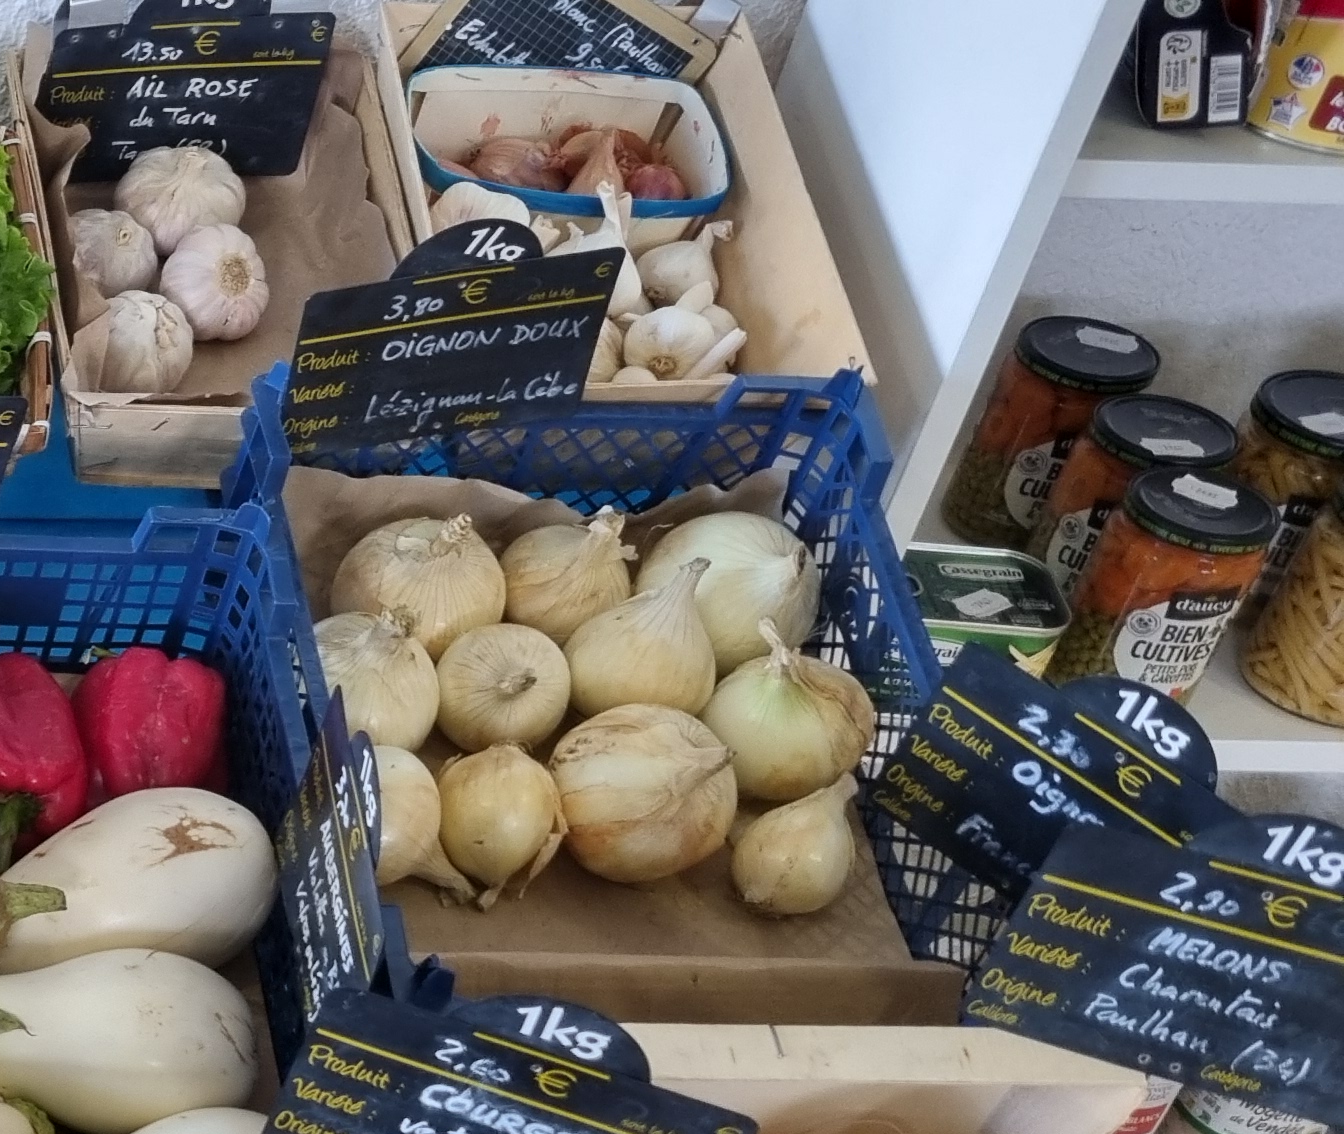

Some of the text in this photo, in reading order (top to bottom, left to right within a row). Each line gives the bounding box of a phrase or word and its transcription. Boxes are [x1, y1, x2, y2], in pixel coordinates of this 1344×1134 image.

[49, 85, 105, 105] Produit
[184, 77, 259, 98] ROSE
[129, 106, 216, 128] du Tarn
[296, 351, 361, 373] Produit
[927, 702, 993, 760] Produit
[1115, 688, 1192, 760] 1kg
[1261, 824, 1344, 887] 1kg
[1028, 892, 1293, 984] Produit MELONS
[515, 1004, 612, 1063] 1kg
[307, 1043, 391, 1091] Produit
